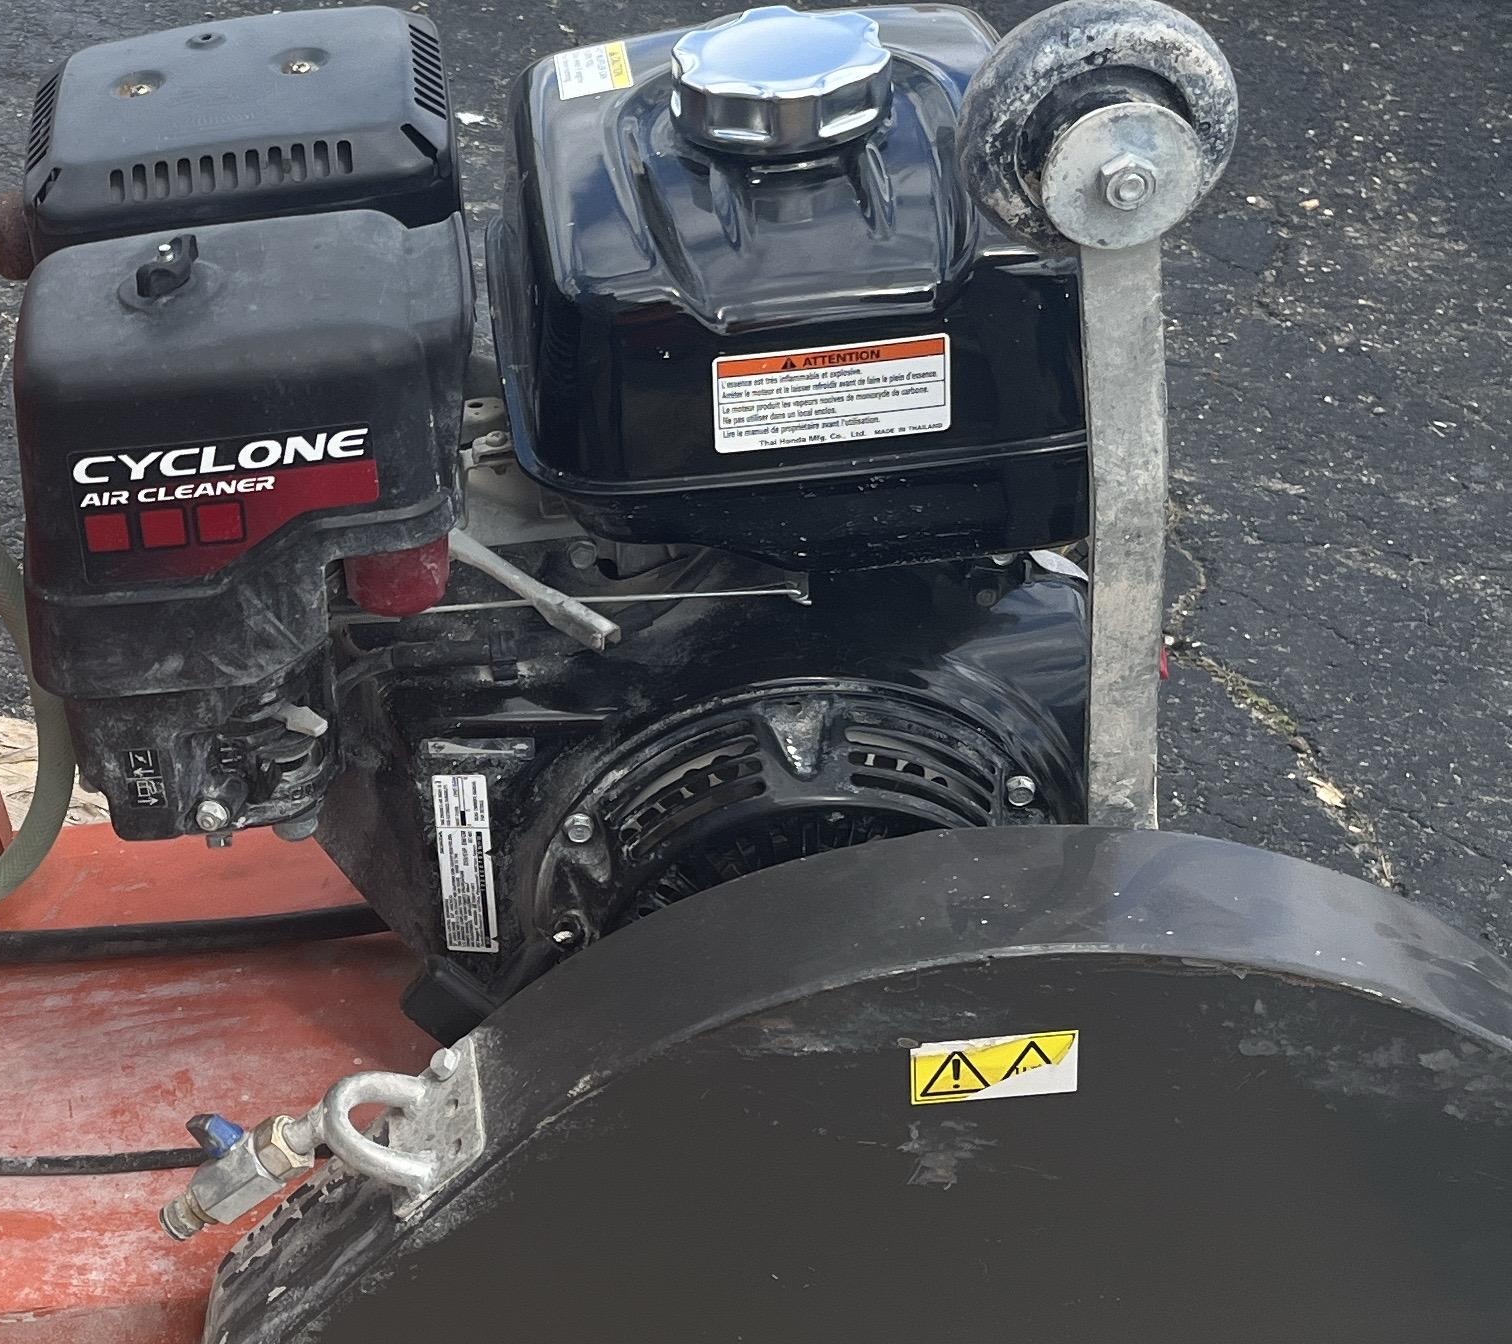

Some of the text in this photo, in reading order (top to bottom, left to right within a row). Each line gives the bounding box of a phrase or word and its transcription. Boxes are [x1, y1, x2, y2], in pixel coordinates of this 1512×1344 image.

[802, 349, 881, 367] ATTENTION
[759, 439, 777, 447] Thai
[779, 436, 807, 445] Honda
[808, 434, 827, 443] Mfg.
[874, 427, 895, 435] MADE
[908, 422, 943, 431] THAILAND
[72, 426, 369, 485] CYCLONE
[80, 475, 276, 508] AIR CLEANER
